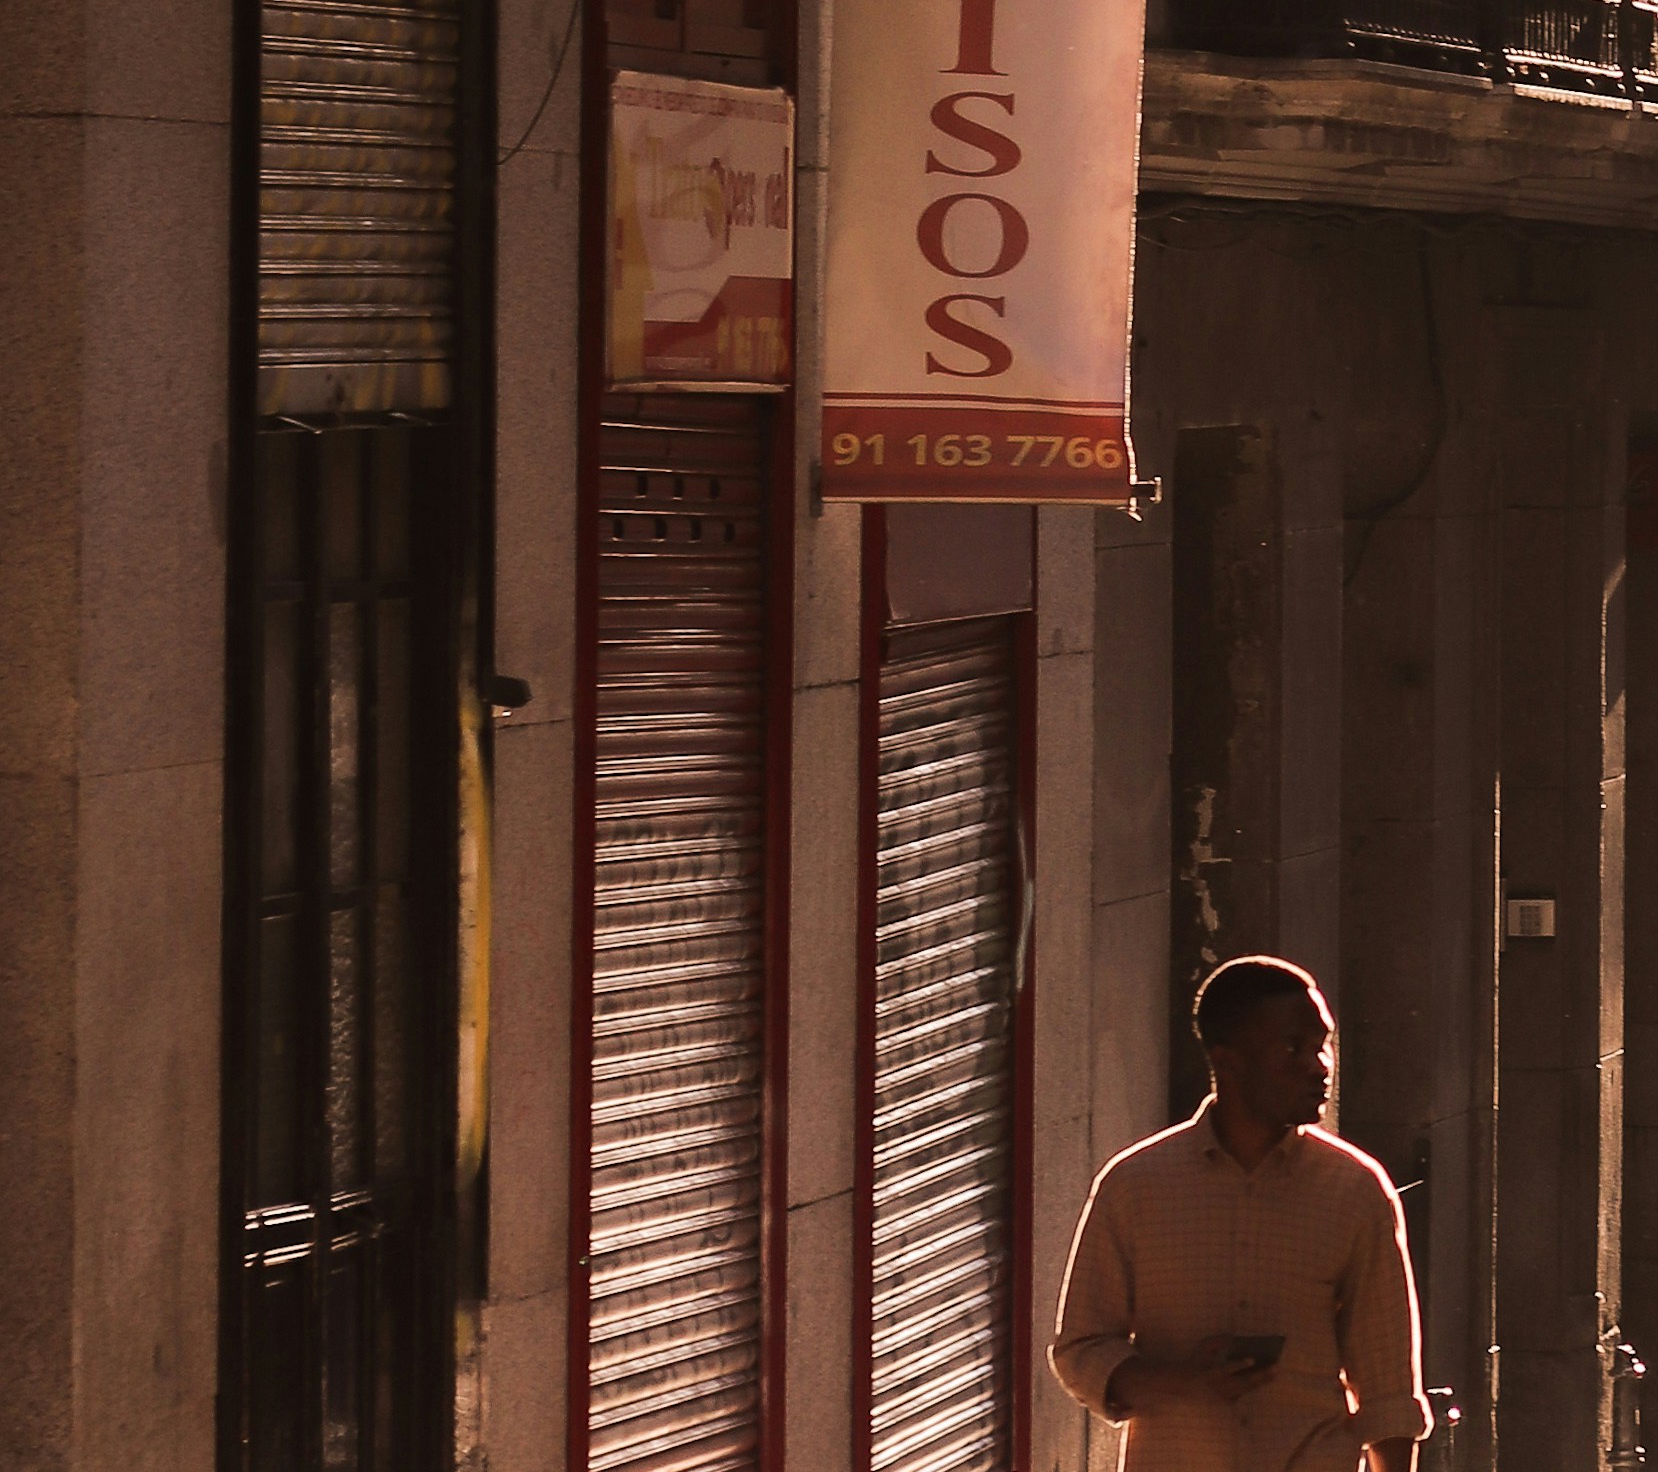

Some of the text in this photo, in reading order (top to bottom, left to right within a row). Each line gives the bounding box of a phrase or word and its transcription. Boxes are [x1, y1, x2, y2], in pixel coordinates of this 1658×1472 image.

[832, 433, 1122, 470] 91 163 7766
